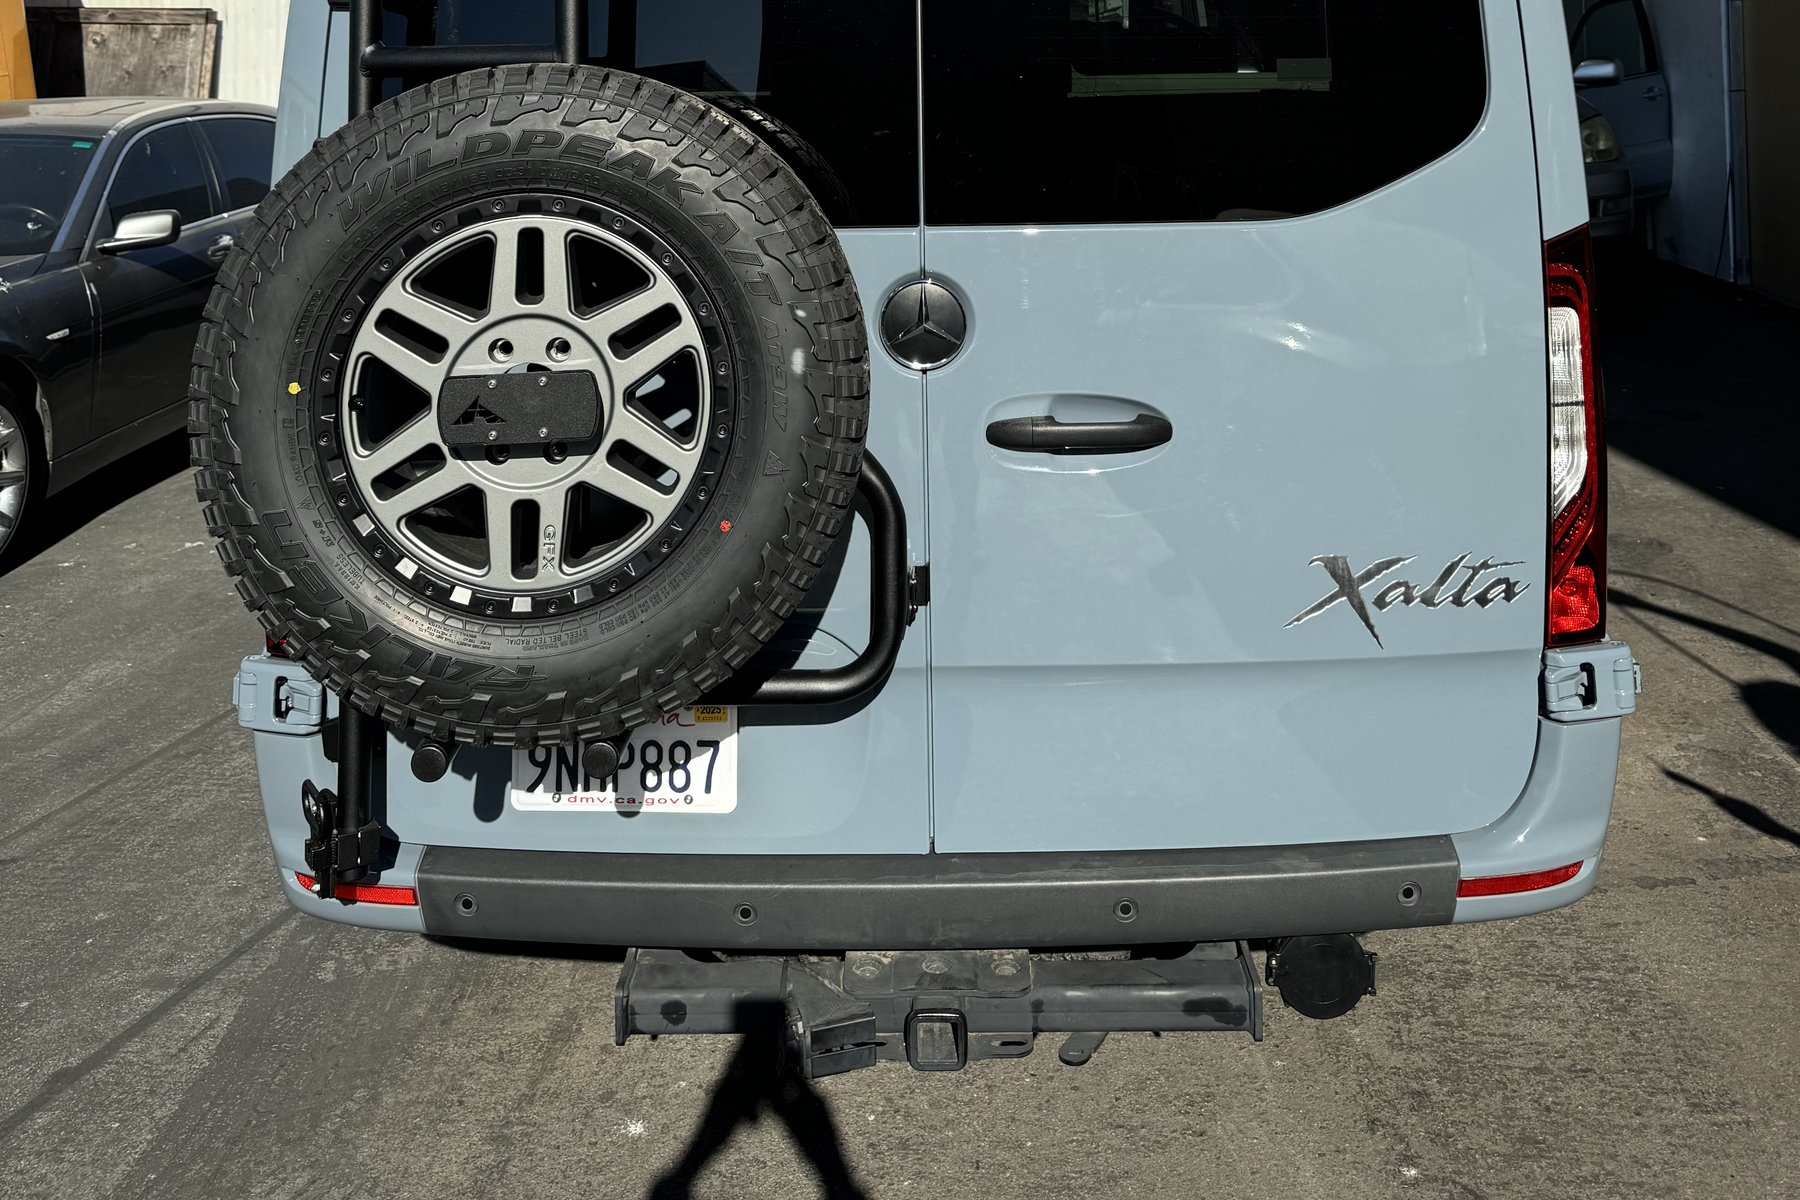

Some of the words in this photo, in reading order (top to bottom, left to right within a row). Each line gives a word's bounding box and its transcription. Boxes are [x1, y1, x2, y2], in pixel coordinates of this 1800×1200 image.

[337, 128, 703, 233] WILDPEAK
[758, 315, 790, 433] AT3W
[285, 432, 299, 462] RANGE
[290, 463, 306, 488] LOAD
[542, 525, 556, 572] GFX
[334, 552, 366, 585] TUBELESS
[1281, 551, 1531, 650] Xalta
[504, 636, 530, 645] RADIAL
[532, 633, 562, 644] BELTED
[563, 627, 588, 640] STEEL
[700, 706, 721, 714] 2025
[567, 794, 681, 806] dmv.ca.gov
